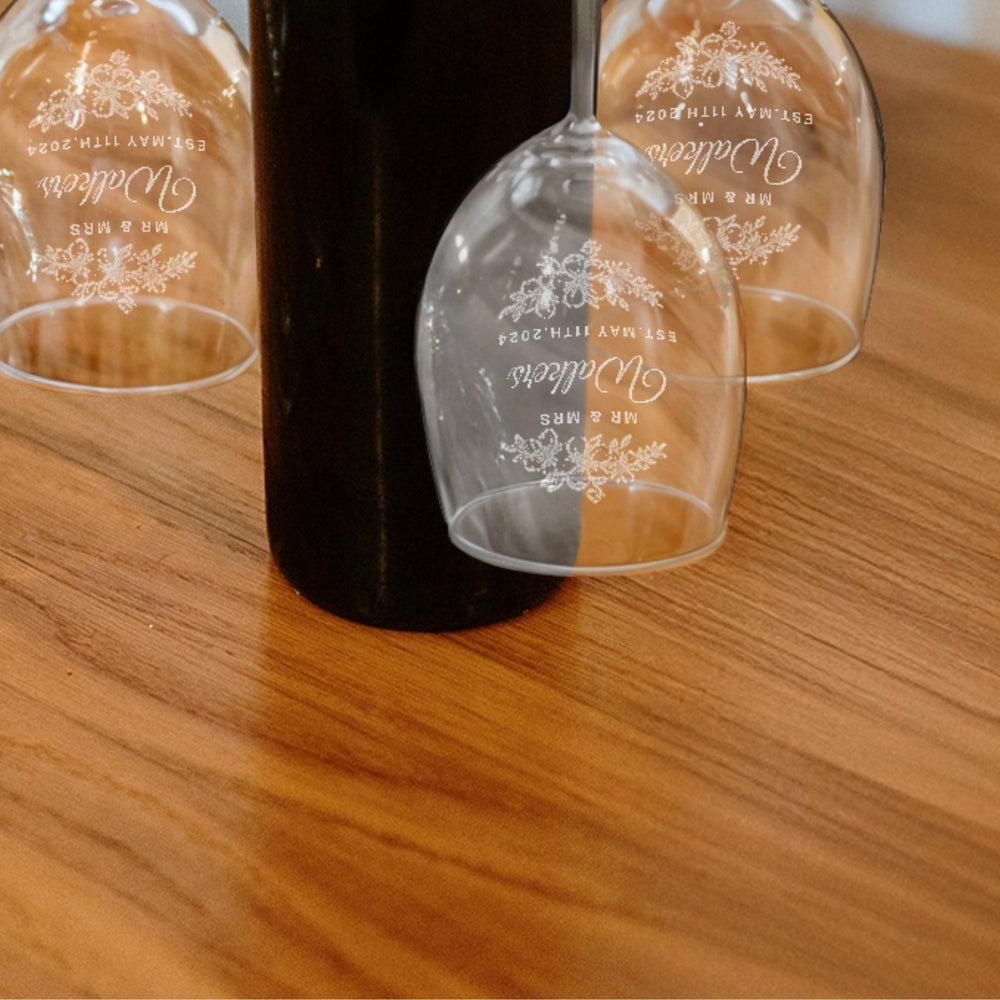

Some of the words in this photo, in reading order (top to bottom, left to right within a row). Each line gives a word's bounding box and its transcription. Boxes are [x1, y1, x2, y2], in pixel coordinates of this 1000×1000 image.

[644, 136, 803, 186] Walkers
[37, 164, 198, 214] Walkers
[674, 191, 714, 205] MRS
[725, 191, 736, 203] &
[744, 192, 772, 206] MR
[69, 221, 111, 236] MRS
[121, 221, 132, 233] &
[141, 221, 169, 234] MR
[506, 355, 667, 404] Walkers
[540, 410, 581, 426] MRS
[590, 410, 602, 423] &
[611, 410, 638, 424] MR
